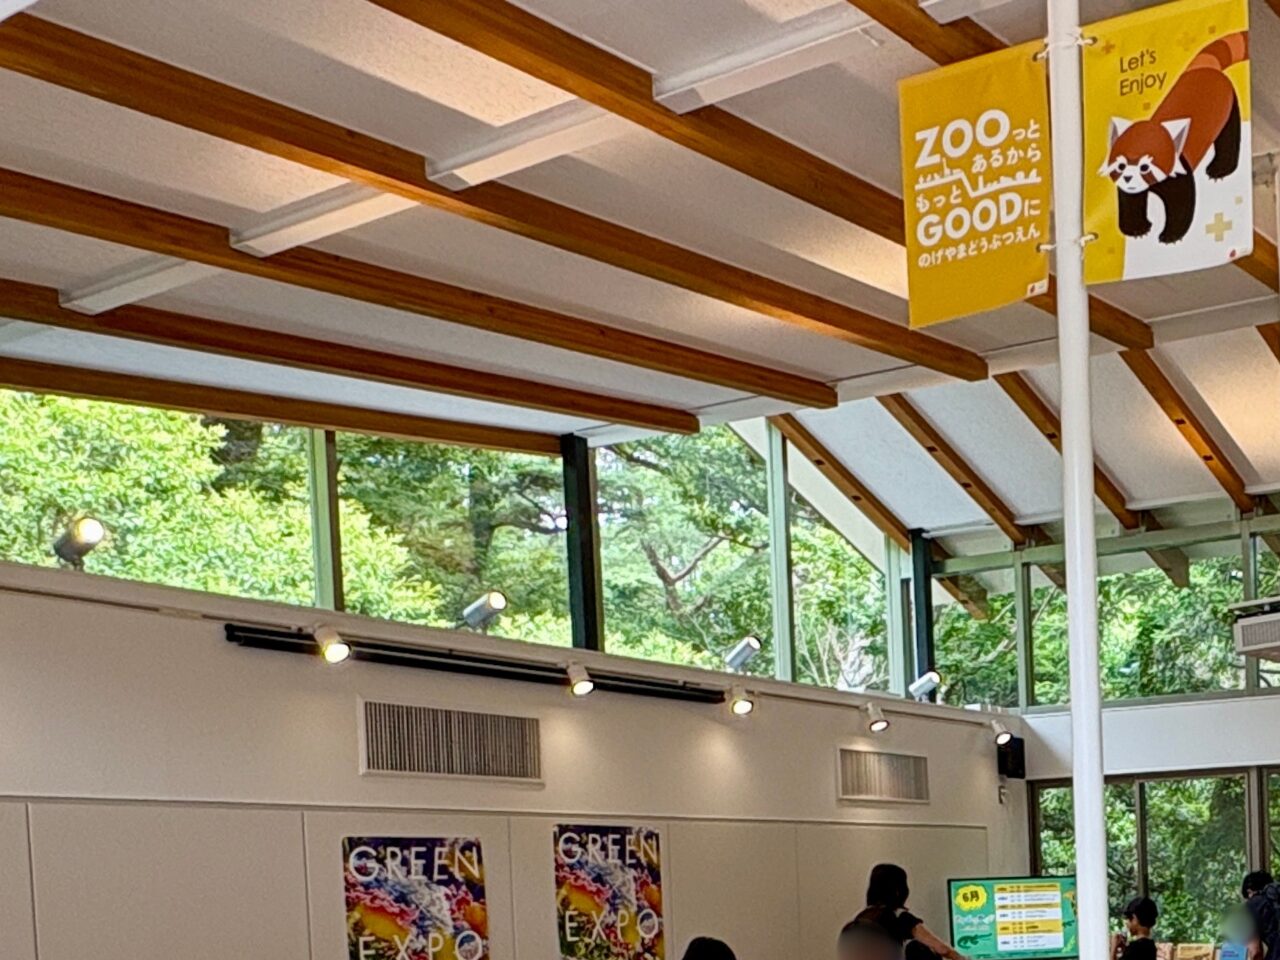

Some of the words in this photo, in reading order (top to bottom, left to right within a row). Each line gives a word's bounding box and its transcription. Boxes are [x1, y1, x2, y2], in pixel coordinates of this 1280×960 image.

[1119, 50, 1157, 73] Let's
[1119, 72, 1168, 97] Enjoy
[971, 143, 1041, 173] あるから
[916, 184, 962, 213] もっと
[918, 222, 1041, 268] のげやまどうぶつえん
[558, 832, 659, 865] GREEN
[349, 846, 481, 882] GREEN
[962, 890, 980, 903] 6月
[565, 909, 659, 942] EXPO
